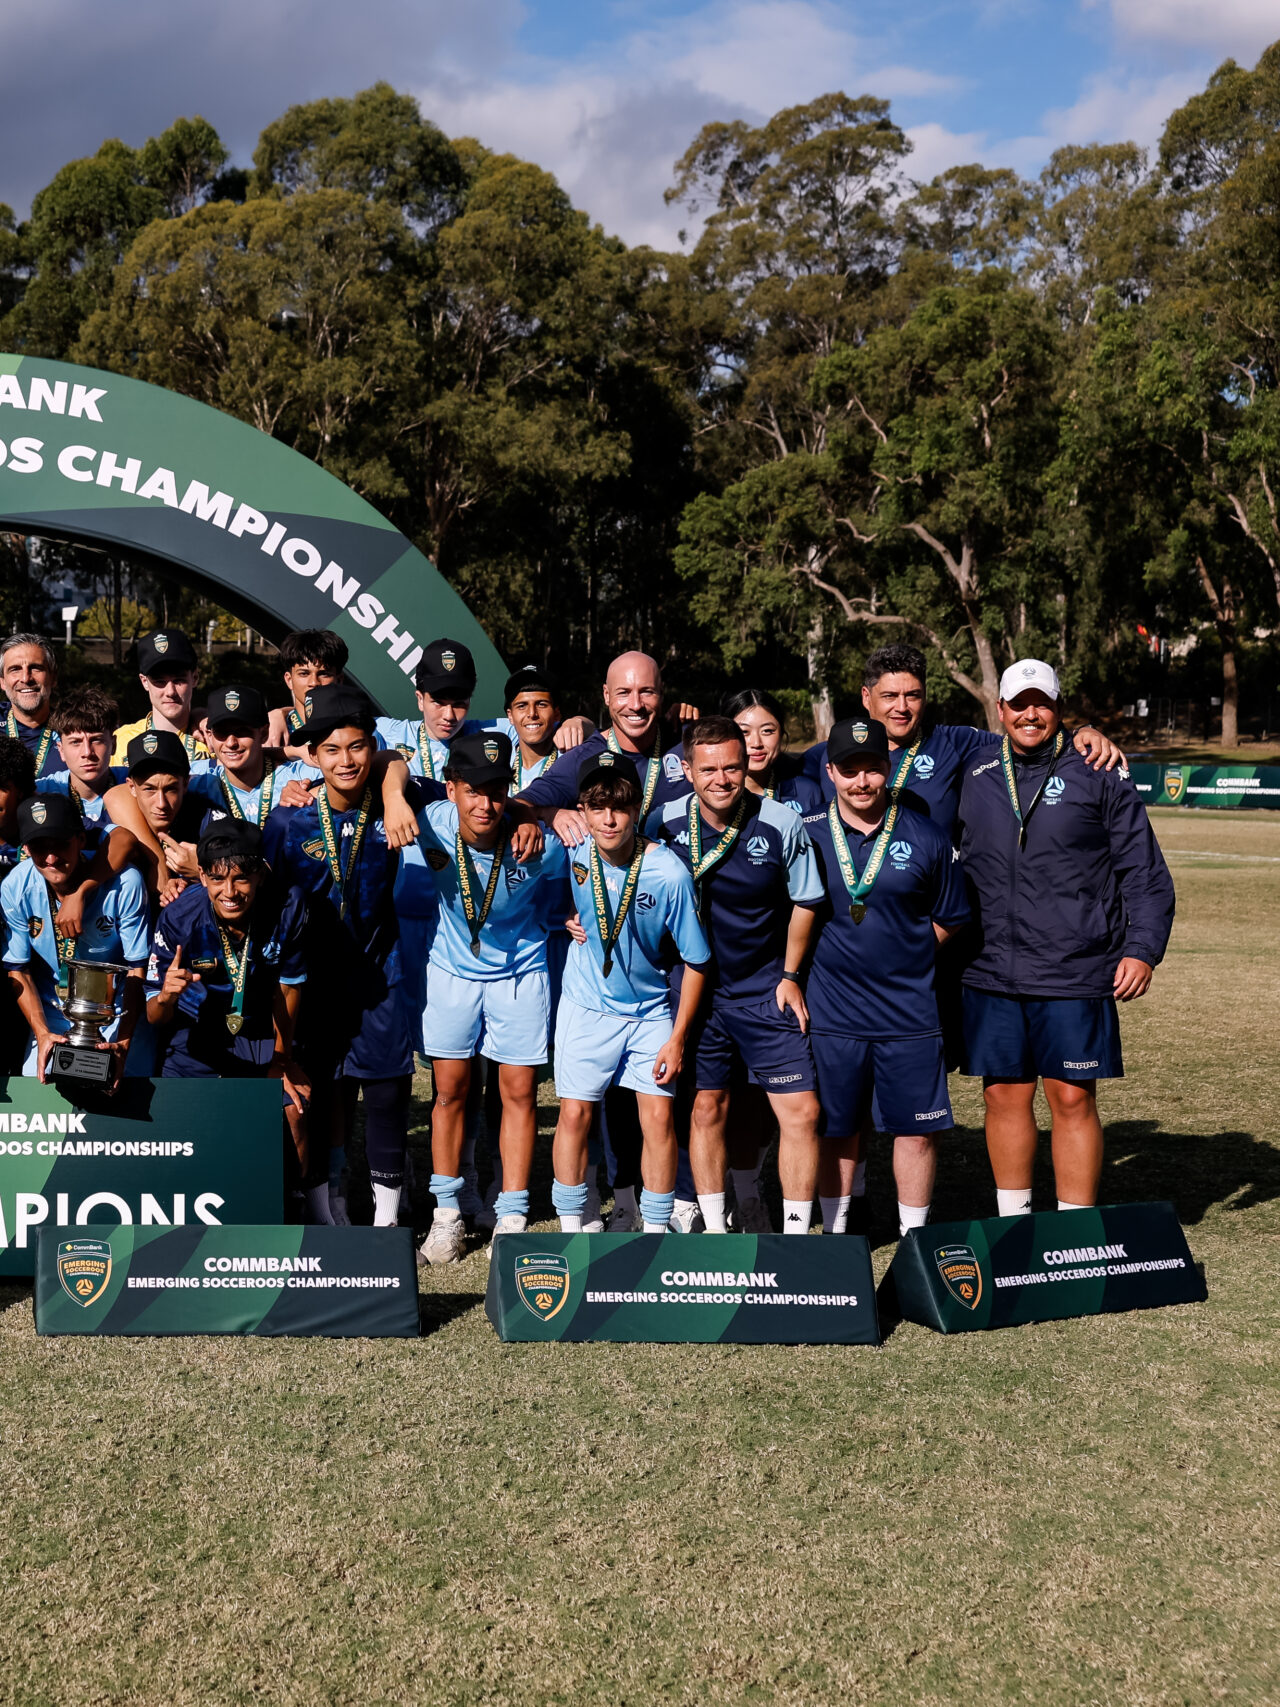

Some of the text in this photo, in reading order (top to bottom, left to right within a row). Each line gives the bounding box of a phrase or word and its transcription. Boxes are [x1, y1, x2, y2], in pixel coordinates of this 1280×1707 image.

[57, 445, 424, 682] CHAMPIONSHI
[890, 755, 913, 797] OMMBANK
[260, 801, 270, 829] BANK
[346, 786, 373, 880] COMMBANK EMERGI
[690, 793, 699, 864] AMPIONSHIPS
[829, 801, 856, 886] AMPIONSHIPS 2026
[864, 802, 898, 885] COMMBANK EMERG
[330, 859, 341, 882] 2026
[456, 832, 474, 920] AMPIONSHIPS 2026
[479, 868, 500, 922] COMMBANK
[612, 885, 634, 941] COMMBANK
[598, 917, 608, 940] 2026
[219, 926, 238, 975] IONSHIPS
[1063, 1060, 1098, 1070] Kappa
[769, 1073, 802, 1084] Kappa
[915, 1108, 948, 1122] Kappa
[36, 1140, 194, 1157] CHAMPIONSHIPS
[64, 1260, 106, 1269] EMERGING
[204, 1257, 322, 1272] COMMBANK
[1043, 1244, 1128, 1266] COMMBANK
[522, 1274, 564, 1283] EMERGING
[660, 1271, 779, 1288] COMMBANK
[944, 1264, 976, 1275] EMERGING
[994, 1258, 1186, 1288] EMERGING SOCCEROOS CHAMPIONSHIPS
[127, 1277, 400, 1289] EMERGING SOCCEROOS CHAMPIONSHIPS
[586, 1291, 858, 1307] EMERGING SOCCEROOS CHAMPIONSHIPS
